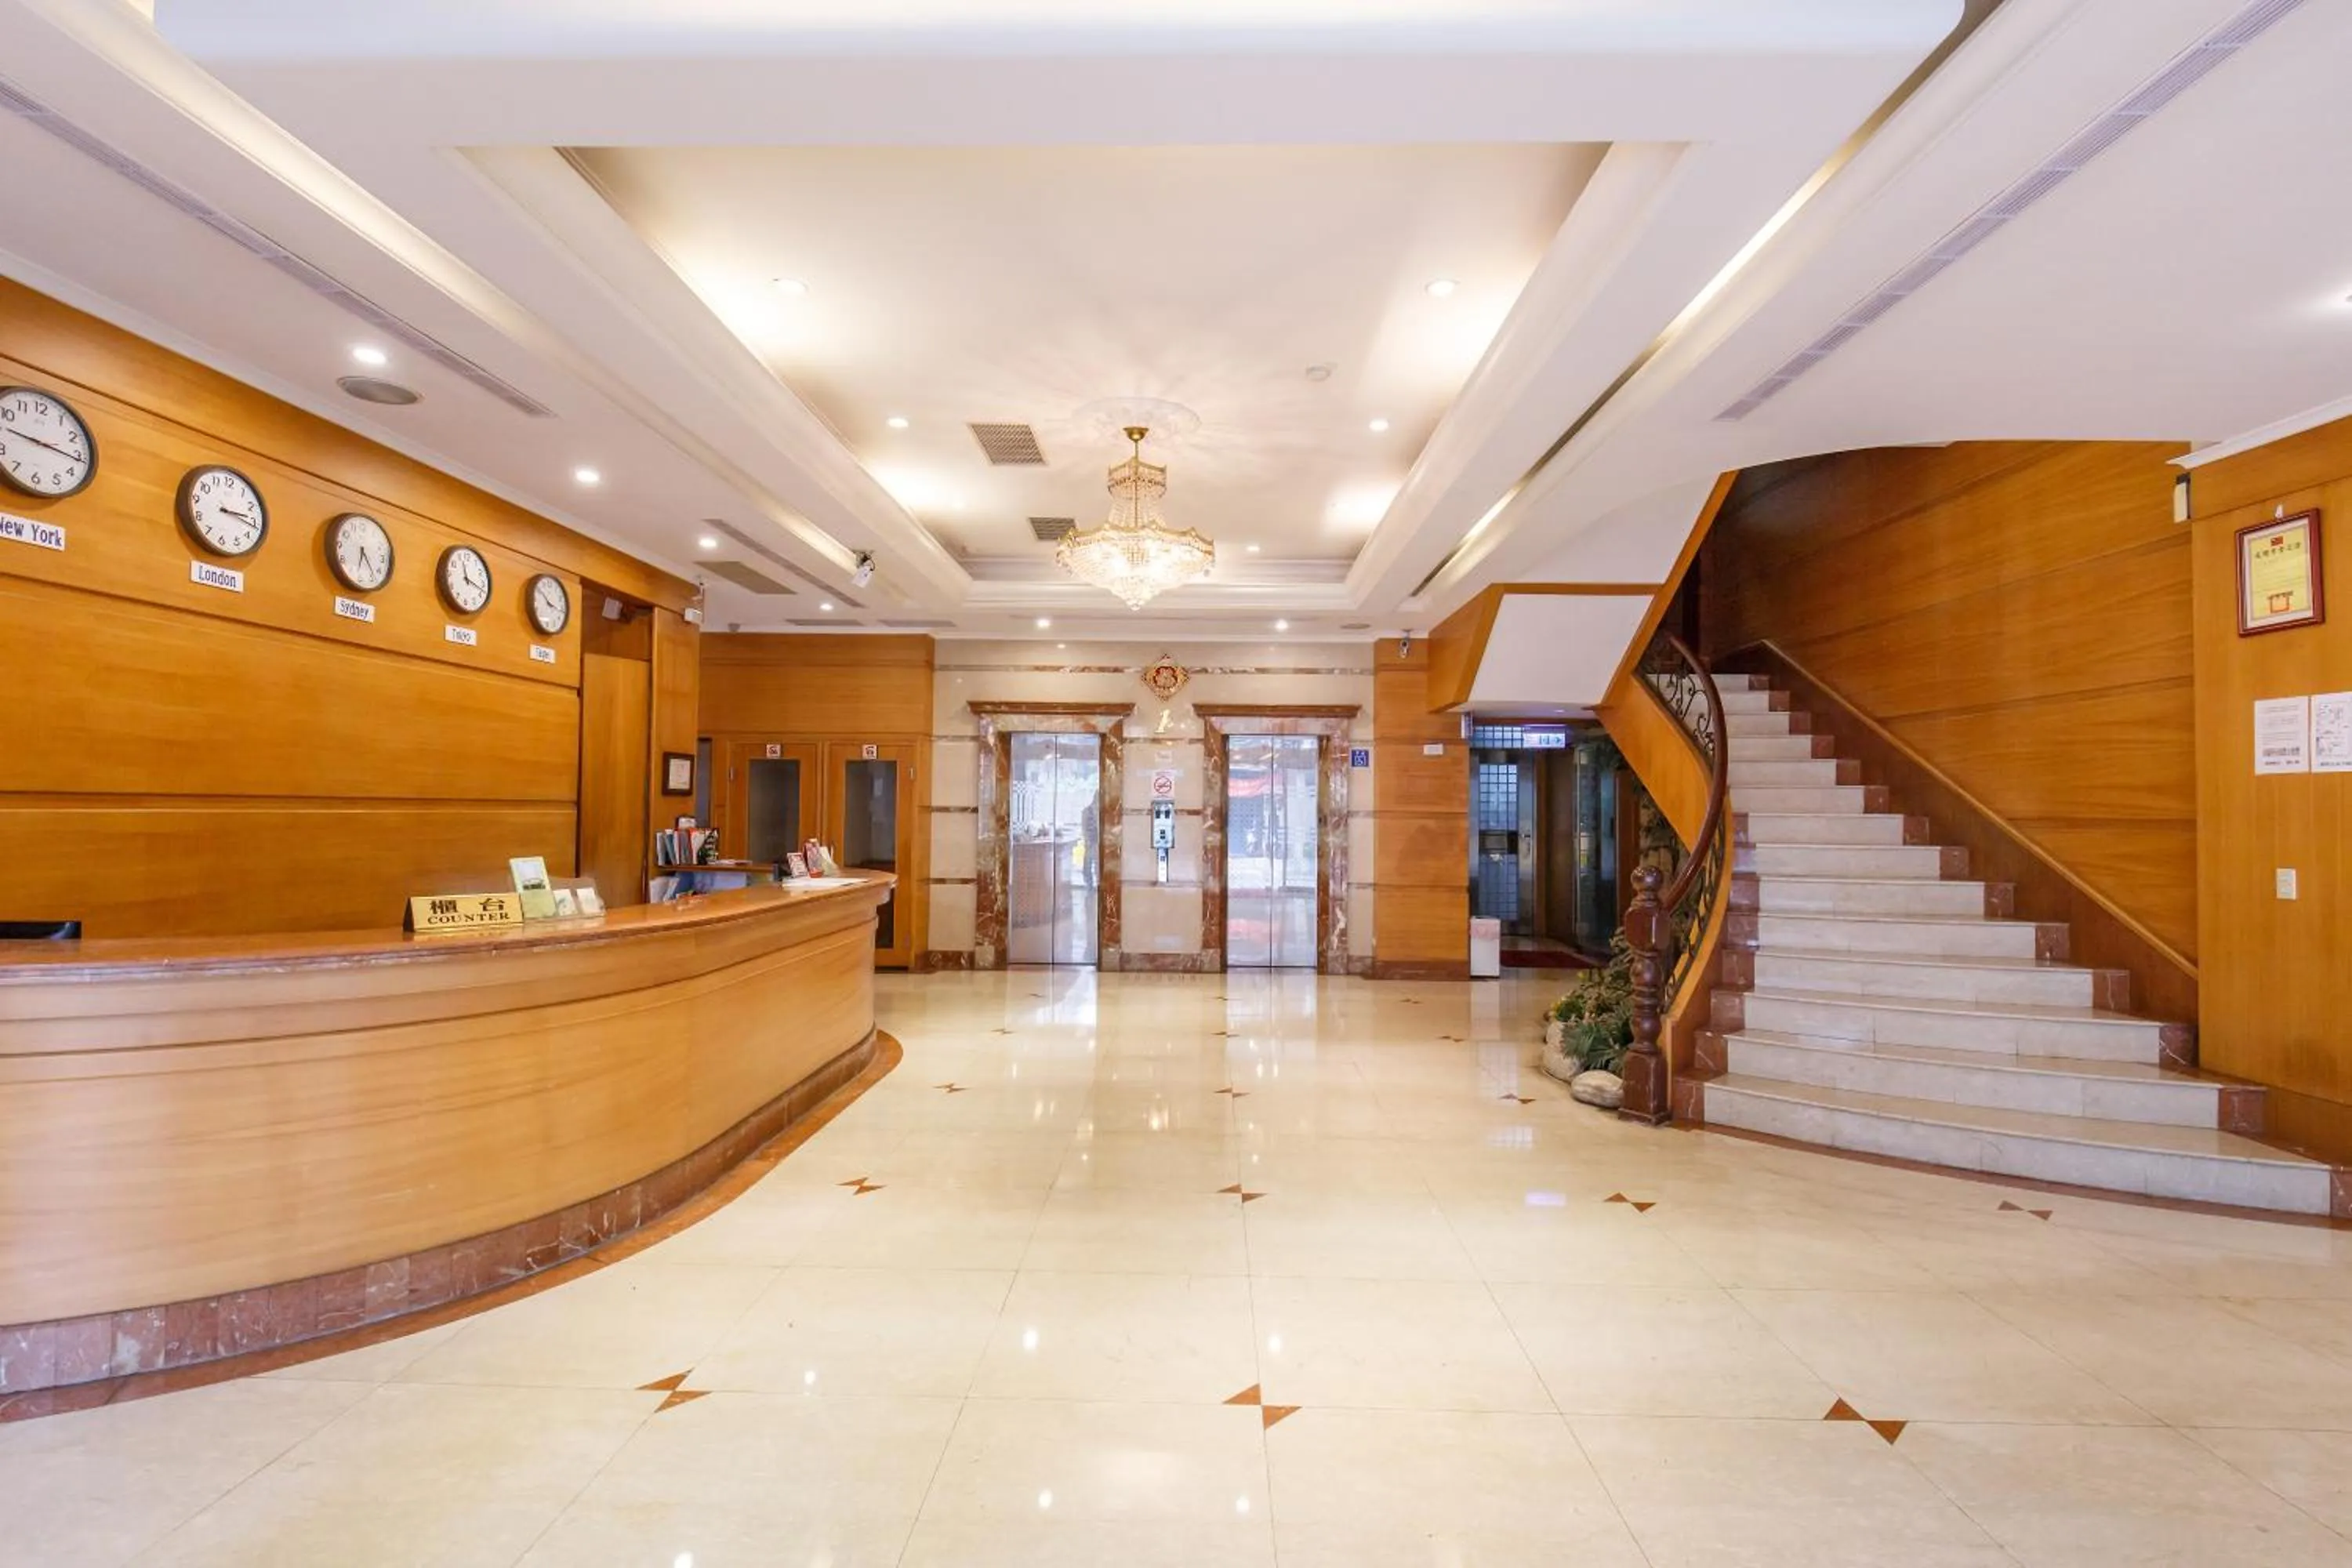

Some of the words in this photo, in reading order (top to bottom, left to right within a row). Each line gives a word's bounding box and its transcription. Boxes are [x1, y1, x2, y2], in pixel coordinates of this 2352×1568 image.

[16, 398, 28, 415] 11
[34, 401, 48, 416] 12
[1, 406, 15, 422] 10
[58, 416, 64, 426] 1
[68, 430, 78, 444] 2
[74, 449, 82, 462] 3
[12, 459, 21, 472] 7
[66, 466, 75, 477] 4
[31, 472, 41, 485] 6
[52, 473, 61, 485] 5
[212, 476, 220, 487] 11
[224, 476, 234, 489] 12
[200, 481, 211, 495] 10
[248, 501, 255, 511] 2
[195, 510, 202, 521] 8
[31, 523, 63, 547] York
[205, 525, 212, 535] 7
[244, 531, 250, 539] 4
[217, 535, 225, 546] 6
[233, 536, 240, 546] 5
[198, 564, 237, 588] London
[339, 600, 369, 619] Sydney
[427, 912, 510, 925] COUNTER
